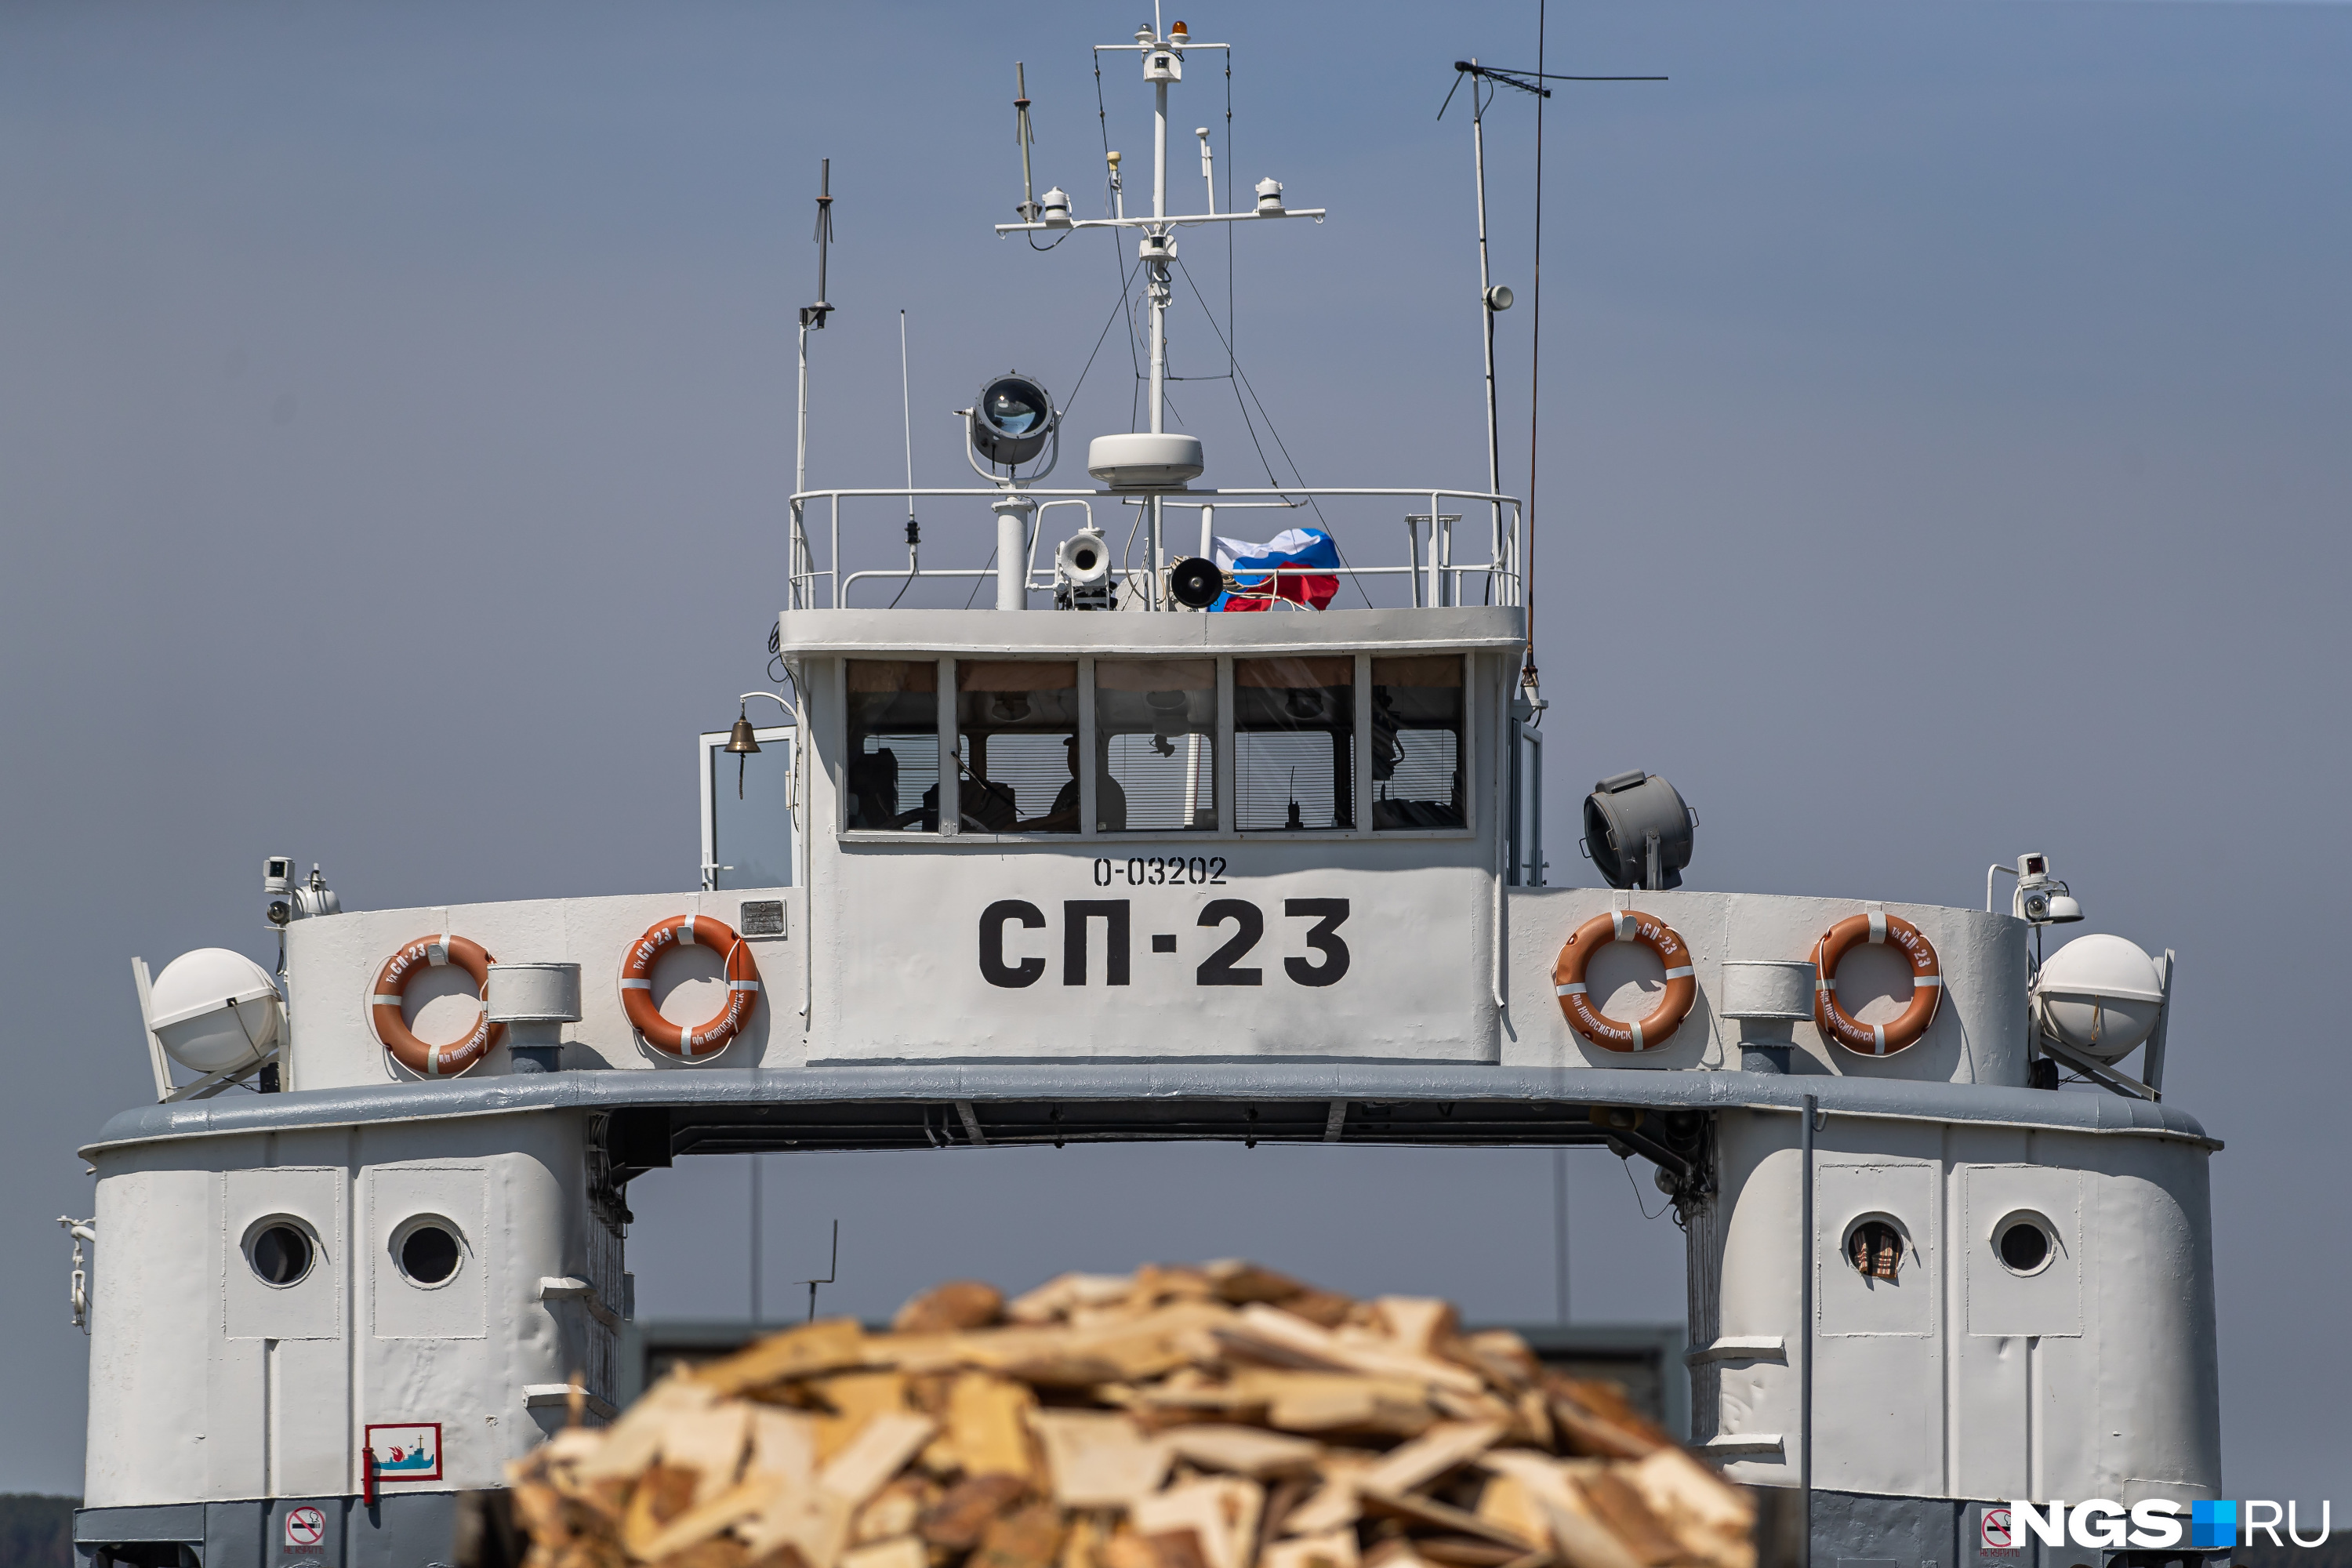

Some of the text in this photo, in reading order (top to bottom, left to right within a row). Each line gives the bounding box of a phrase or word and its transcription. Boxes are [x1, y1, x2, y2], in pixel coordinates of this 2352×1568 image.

[978, 898, 1350, 989] СП-23
[1577, 1005, 1632, 1040] НОВОСИБИРСК
[1980, 1548, 2020, 1557] НЕ КУРИТЬ
